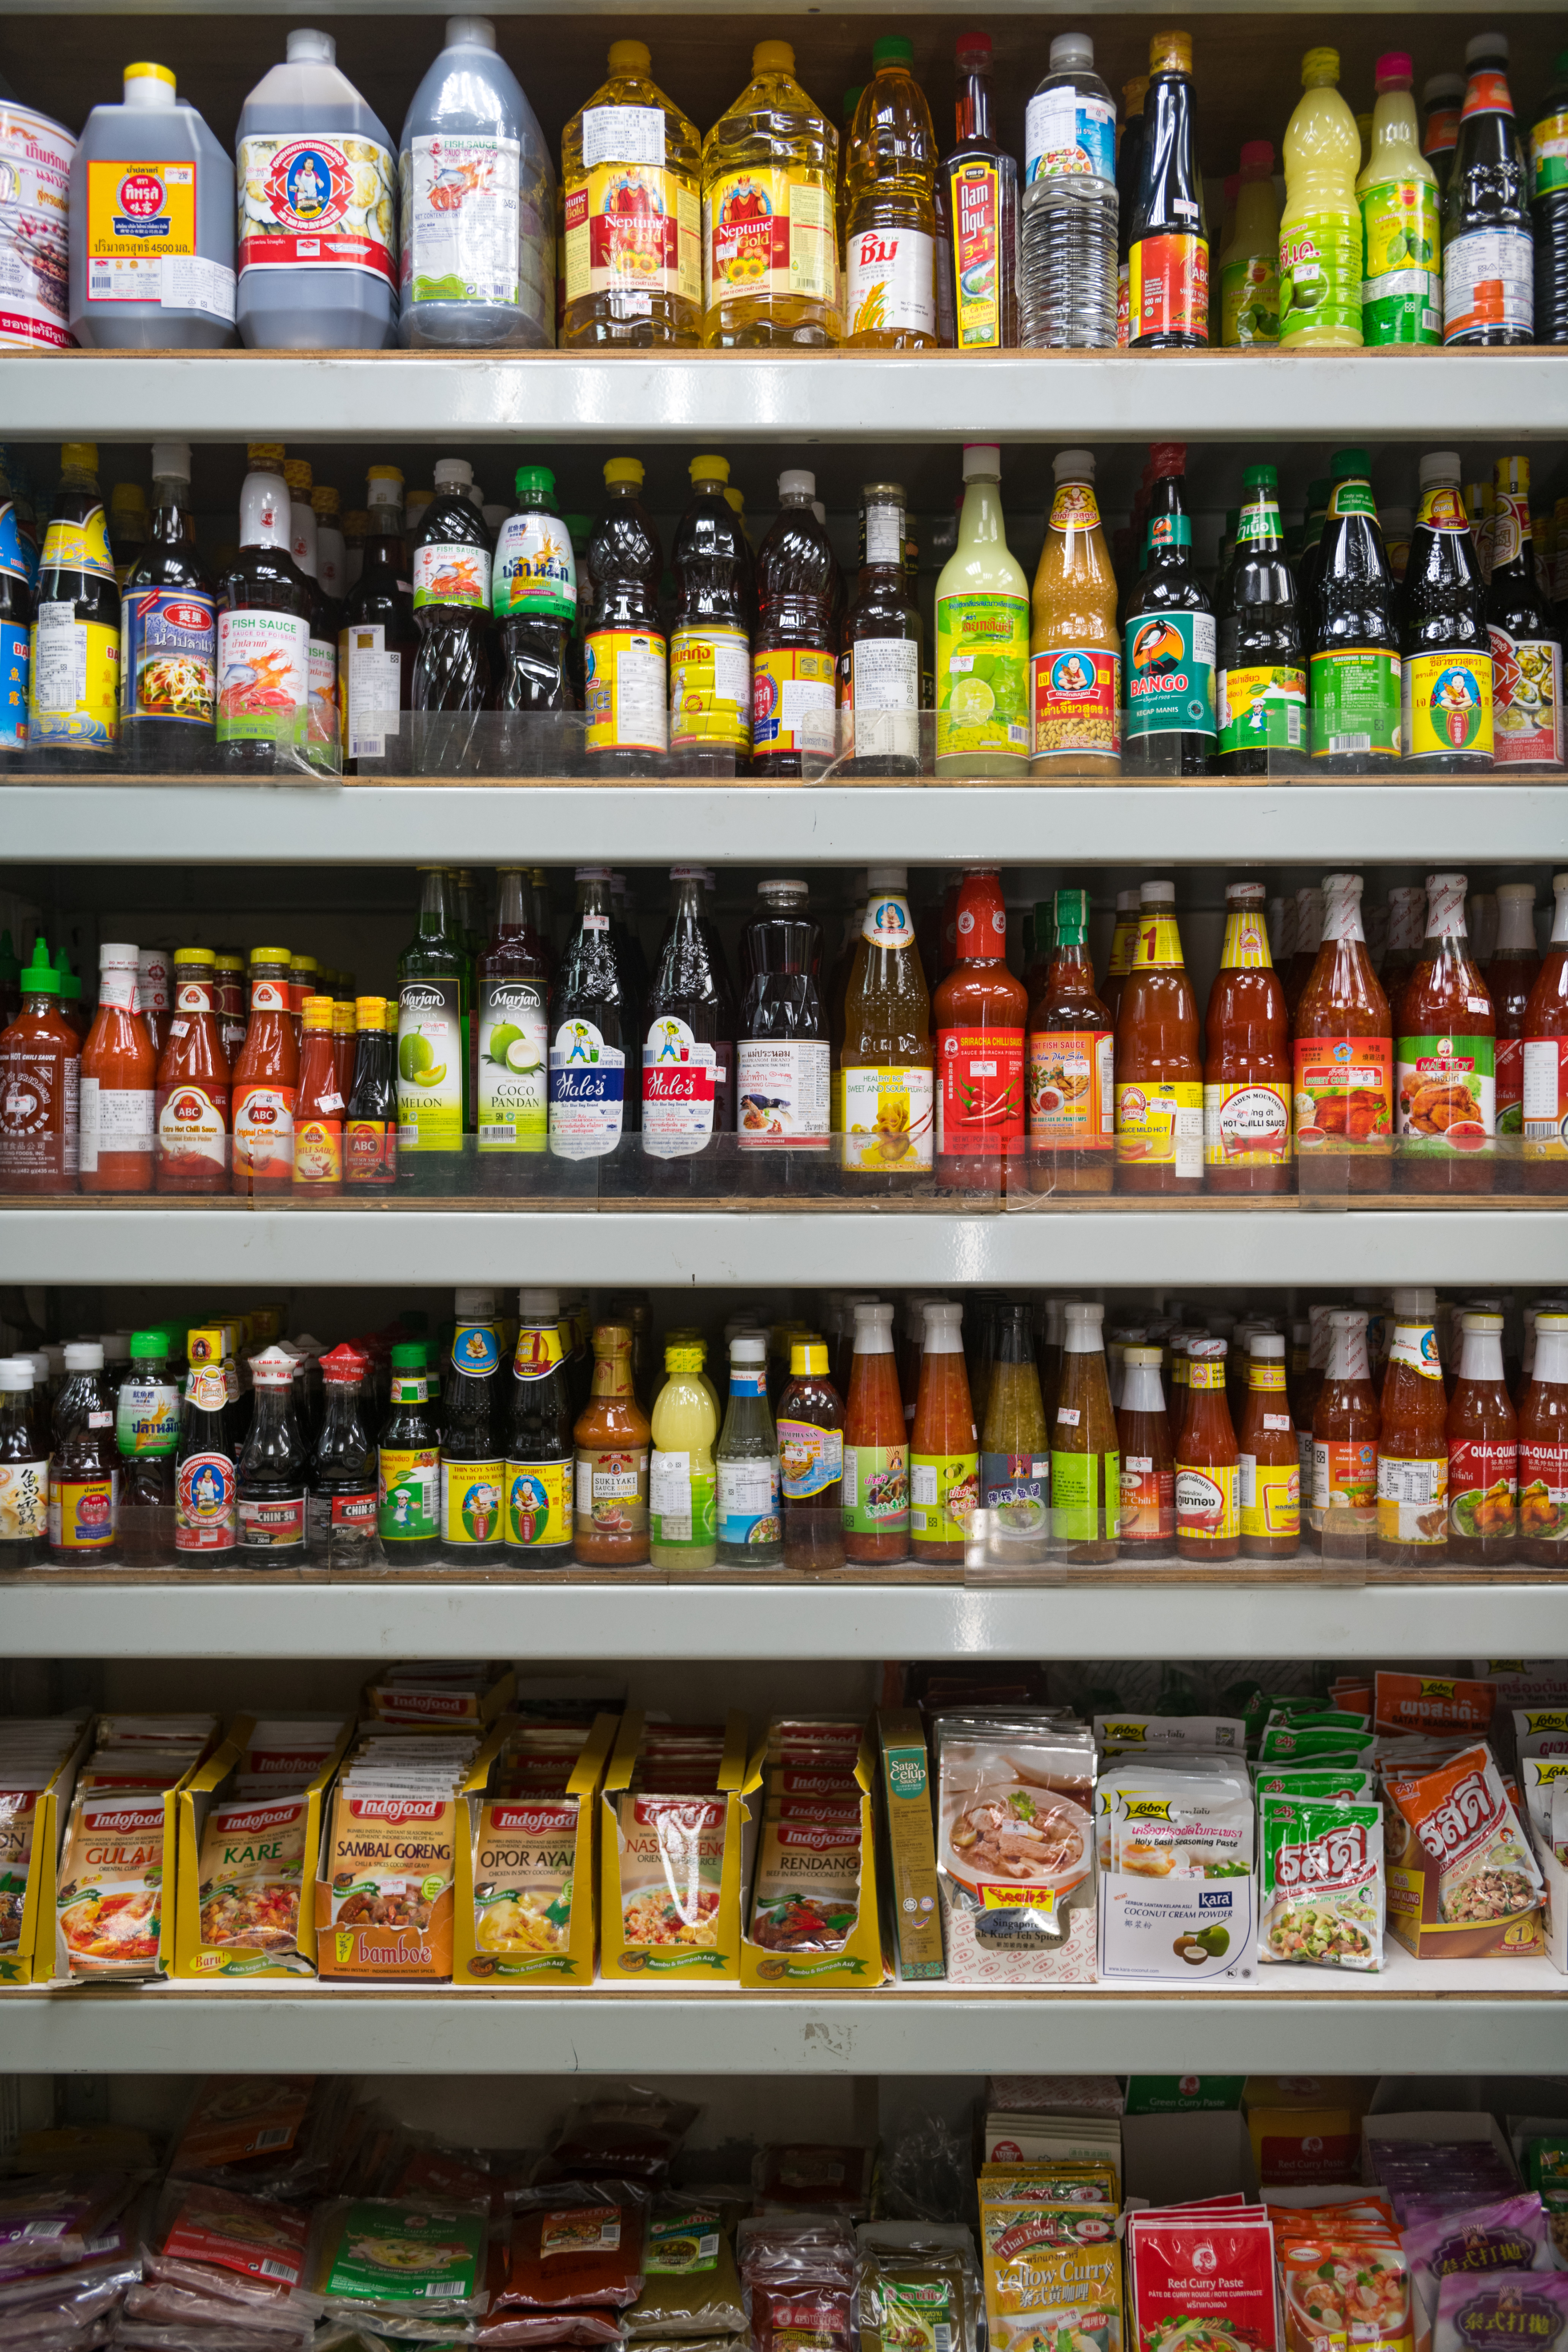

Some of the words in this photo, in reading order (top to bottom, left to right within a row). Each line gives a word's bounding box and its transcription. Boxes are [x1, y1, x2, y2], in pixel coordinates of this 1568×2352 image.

[310, 208, 321, 218] SAUCE
[1375, 212, 1400, 224] LEMON
[719, 220, 772, 239] Neptune
[737, 233, 770, 248] Gold
[151, 243, 173, 253] 4500
[232, 620, 255, 629] FISH
[259, 620, 296, 632] SAUCE
[268, 632, 296, 642] POISSON
[1131, 674, 1188, 697] BANGO
[1136, 708, 1155, 717] KECAP
[496, 991, 537, 1011] Marjan
[961, 1037, 991, 1045] SRIRACHA
[993, 1037, 1009, 1045] CHILLI
[1010, 1038, 1022, 1046] SAUCE
[1421, 1062, 1443, 1070] MAE
[1447, 1062, 1469, 1070] PLOY
[556, 1071, 605, 1099] Hale's
[253, 1111, 272, 1120] ABC
[258, 1511, 295, 1522] CHIN-SU
[892, 1761, 920, 1773] Satay
[890, 1769, 926, 1782] Celup
[359, 1800, 436, 1821] Indofood
[93, 1811, 164, 1829] Indofood
[786, 1830, 856, 1846] Indofood
[1136, 1838, 1152, 1848] Holy
[1174, 1838, 1213, 1848] Seasoning
[1216, 1839, 1238, 1847] Paste
[86, 1846, 153, 1864] GULAI
[224, 1842, 283, 1863] KARE
[338, 1841, 392, 1857] SAMBAL
[395, 1843, 450, 1859] GORENG
[781, 1857, 857, 1869] RENDANG
[1201, 1894, 1229, 1905] kara
[1402, 1893, 1419, 1902] KUNG
[1124, 1908, 1165, 1917] COCONUT
[1168, 1909, 1197, 1918] CREAM
[994, 1919, 1039, 1930] Singapore
[989, 1931, 1012, 1940] Kuet
[1016, 1932, 1032, 1940] Teh
[1034, 1933, 1064, 1944] Spices
[359, 1933, 432, 1964] bamboe
[196, 1951, 225, 1968] Baru!
[788, 1966, 810, 1975] Bumbu
[817, 1963, 841, 1973] Rempah
[1000, 2233, 1024, 2257] Thai
[1026, 2225, 1054, 2240] Food
[995, 2263, 1056, 2291] Yellow
[1060, 2260, 1114, 2282] Curry
[1168, 2279, 1187, 2288] Red
[1189, 2279, 1216, 2290] Curry
[1218, 2278, 1243, 2287] Paste
